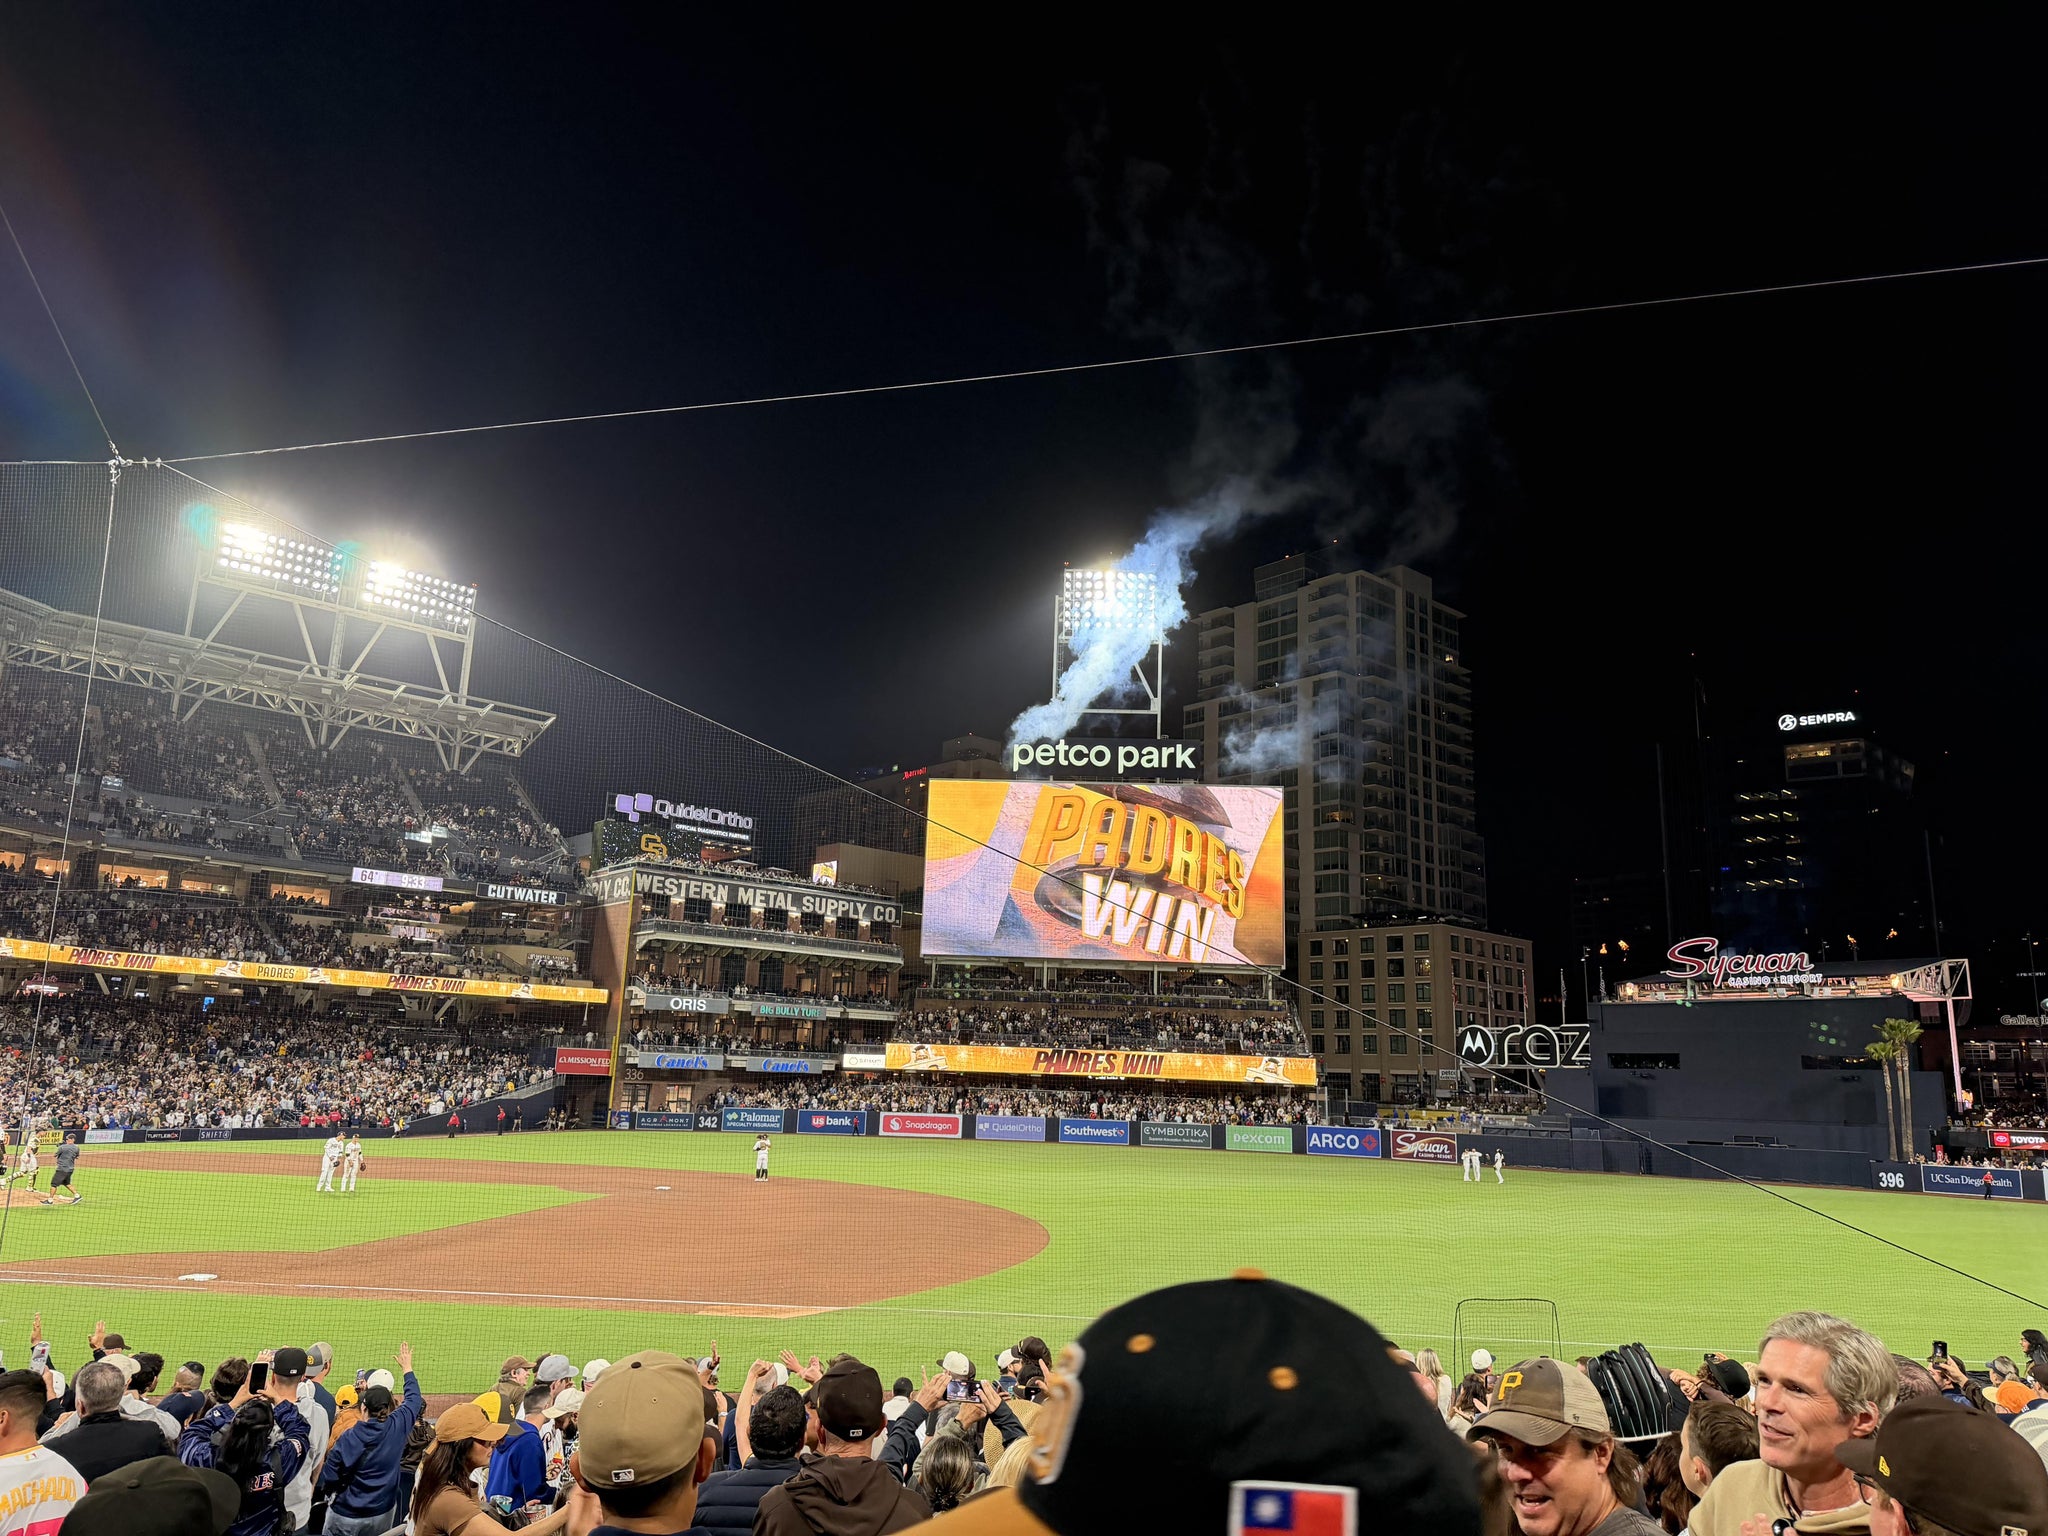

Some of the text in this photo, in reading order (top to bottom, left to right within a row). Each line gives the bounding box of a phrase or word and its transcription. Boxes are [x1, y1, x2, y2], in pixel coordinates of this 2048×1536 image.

[1799, 711, 1856, 726] SEMPRA
[1012, 739, 1196, 774] petco park
[655, 799, 753, 829] QuidelOrtho
[675, 824, 697, 833] OFFICIAL
[729, 831, 749, 840] PARTNER
[1034, 795, 1246, 920] PADRES
[401, 875, 426, 889] 9:33
[487, 884, 558, 904] CUTWATER
[636, 873, 899, 923] WESTERN METAL SUPPLY CO.
[1081, 873, 1216, 963] WIN
[68, 948, 157, 969] PADRES WIN
[1660, 937, 1814, 988] Sycuan
[257, 965, 295, 979] PADRES
[386, 974, 466, 992] PADRES WIN
[1728, 974, 1823, 987] CASINO RESORT
[670, 998, 707, 1011] ORIS
[760, 1005, 774, 1015] BIG
[775, 1006, 800, 1017] BULLY
[568, 1056, 597, 1065] MISSION
[655, 1054, 709, 1069] Canel's
[762, 1058, 809, 1072] Canel's
[1032, 1049, 1164, 1076] PADRES WIN
[624, 1069, 644, 1080] 336
[698, 1116, 718, 1128] 342
[739, 1111, 781, 1122] Palomar
[812, 1116, 851, 1126] us bank
[905, 1120, 952, 1131] Snapdragon
[992, 1123, 1042, 1133] QuidelOrtho
[1063, 1125, 1118, 1137] Southwest
[1143, 1126, 1209, 1138] CYMBIOTIKA
[1309, 1133, 1360, 1149] ARCO
[1396, 1133, 1450, 1158] Sycuan
[2010, 1136, 2046, 1144] TOYOTA
[1878, 1172, 1905, 1188] 396
[1930, 1173, 2013, 1187] UC San Diego ealth
[1498, 1371, 1524, 1400] P
